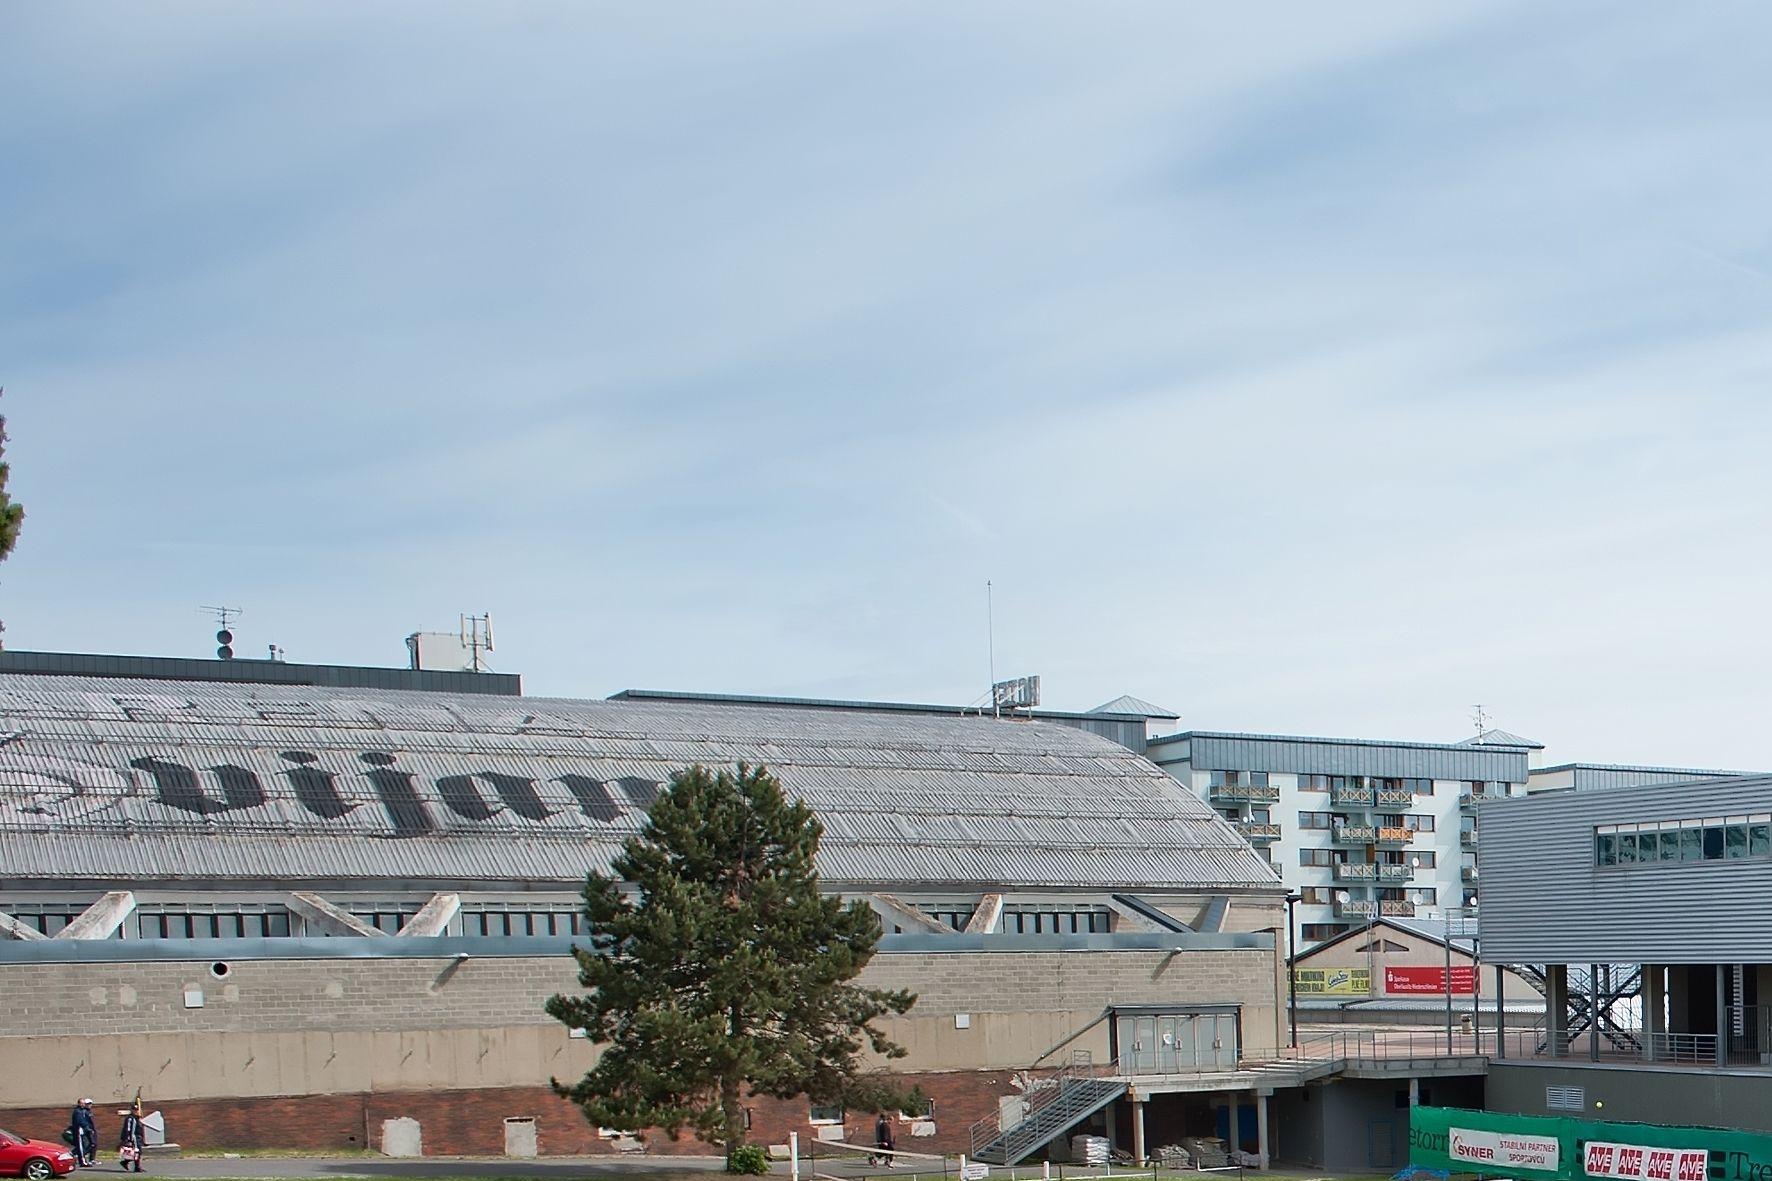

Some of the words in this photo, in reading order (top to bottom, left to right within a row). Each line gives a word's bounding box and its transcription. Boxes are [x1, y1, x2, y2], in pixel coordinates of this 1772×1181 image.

[1458, 1144, 1494, 1159] SYNER
[1528, 1142, 1556, 1153] PARTNER
[1588, 1153, 1611, 1167] AVE
[1619, 1155, 1642, 1170] AVE
[1648, 1158, 1672, 1173] AVE
[1680, 1160, 1704, 1175] AVE
